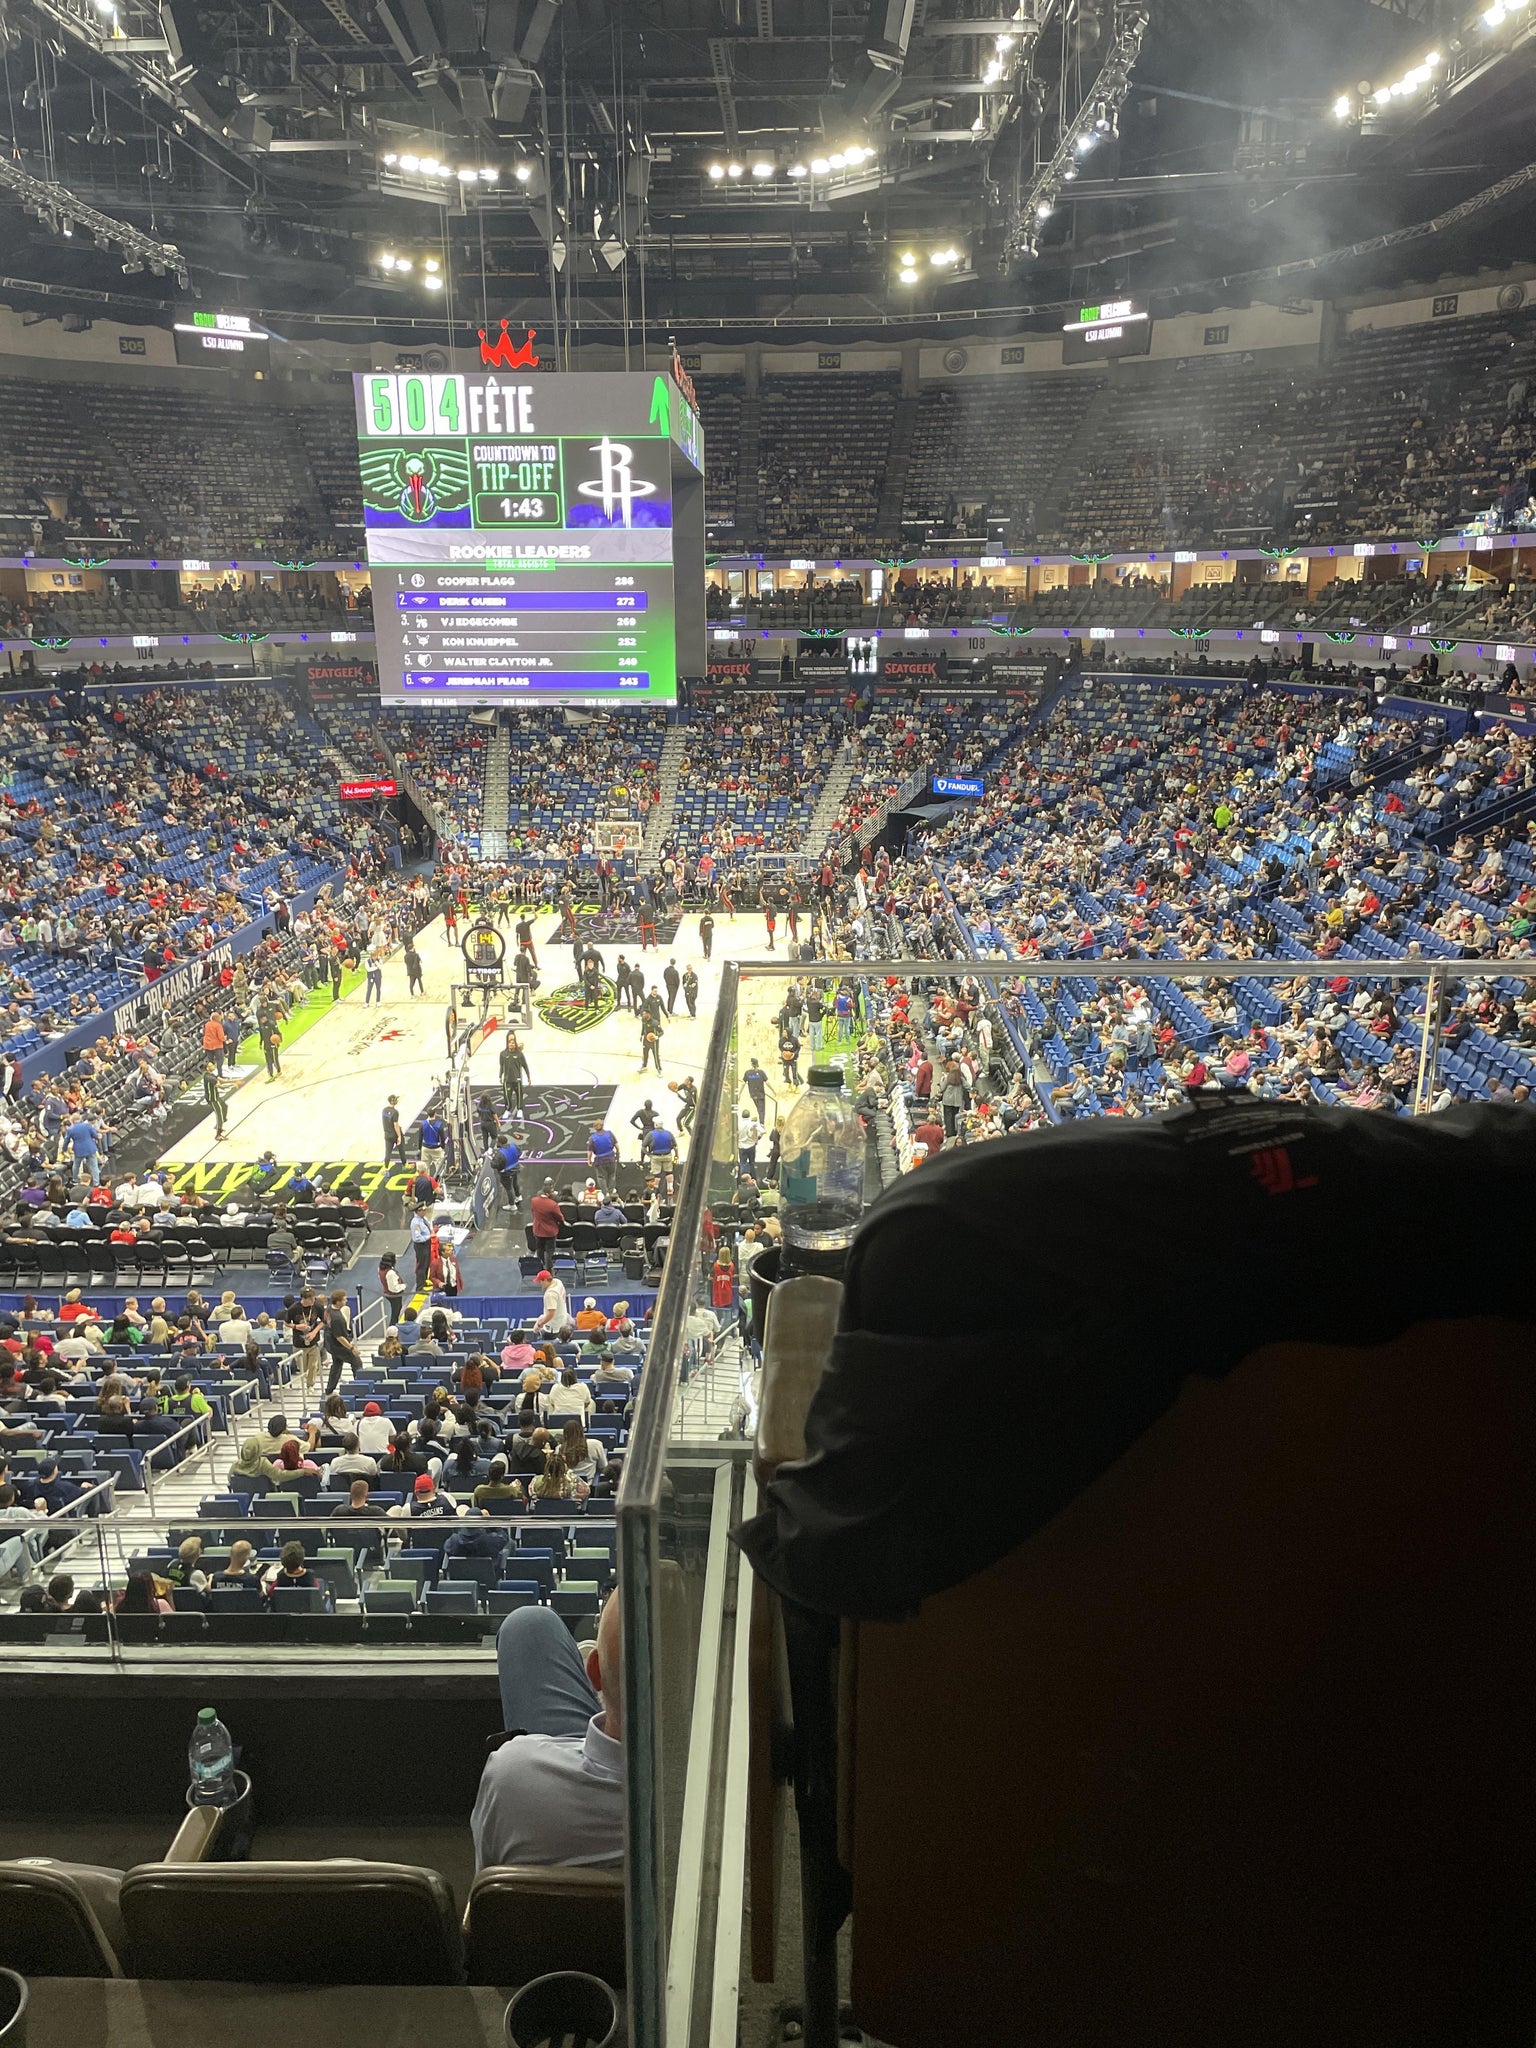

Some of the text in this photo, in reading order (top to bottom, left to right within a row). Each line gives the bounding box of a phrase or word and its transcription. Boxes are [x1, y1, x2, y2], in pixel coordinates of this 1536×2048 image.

[1435, 299, 1457, 313] 312
[1085, 330, 1097, 342] LSU
[1207, 329, 1226, 342] 311
[120, 340, 145, 352] 305
[202, 337, 215, 349] LSU
[681, 357, 700, 368] 308
[819, 355, 840, 366] 309
[371, 376, 535, 433] 504 FÊTE
[473, 445, 556, 462] COUNTDOWN TO
[476, 463, 554, 491] TIP-OFF
[500, 497, 543, 518] 1:43
[450, 545, 592, 559] ROOKIE LEADERS
[437, 577, 479, 586] COOPER
[480, 577, 515, 586] FLAGG
[398, 593, 408, 605] 2.
[471, 597, 507, 606] QUEEN
[616, 597, 635, 606] 272
[400, 614, 410, 626] 3.
[440, 617, 454, 627] VJ
[455, 617, 518, 627] EDGECOMBE
[402, 634, 411, 646] 4.
[442, 637, 465, 647] KON
[466, 637, 519, 647] KNUEPPEL
[740, 638, 756, 651] 107
[968, 637, 986, 650] 108
[1195, 638, 1210, 652] 109
[137, 647, 154, 660] 104
[404, 654, 413, 666] 5.
[443, 657, 487, 667] WALTER
[488, 657, 537, 667] CLAYTON
[308, 666, 363, 680] SEATGEEK
[707, 663, 751, 675] EATGEEK
[884, 663, 937, 676] SEATGEEK
[405, 673, 414, 685] 6.
[497, 677, 530, 686] FEARS
[619, 677, 638, 686] 243
[190, 942, 233, 988] PCANS
